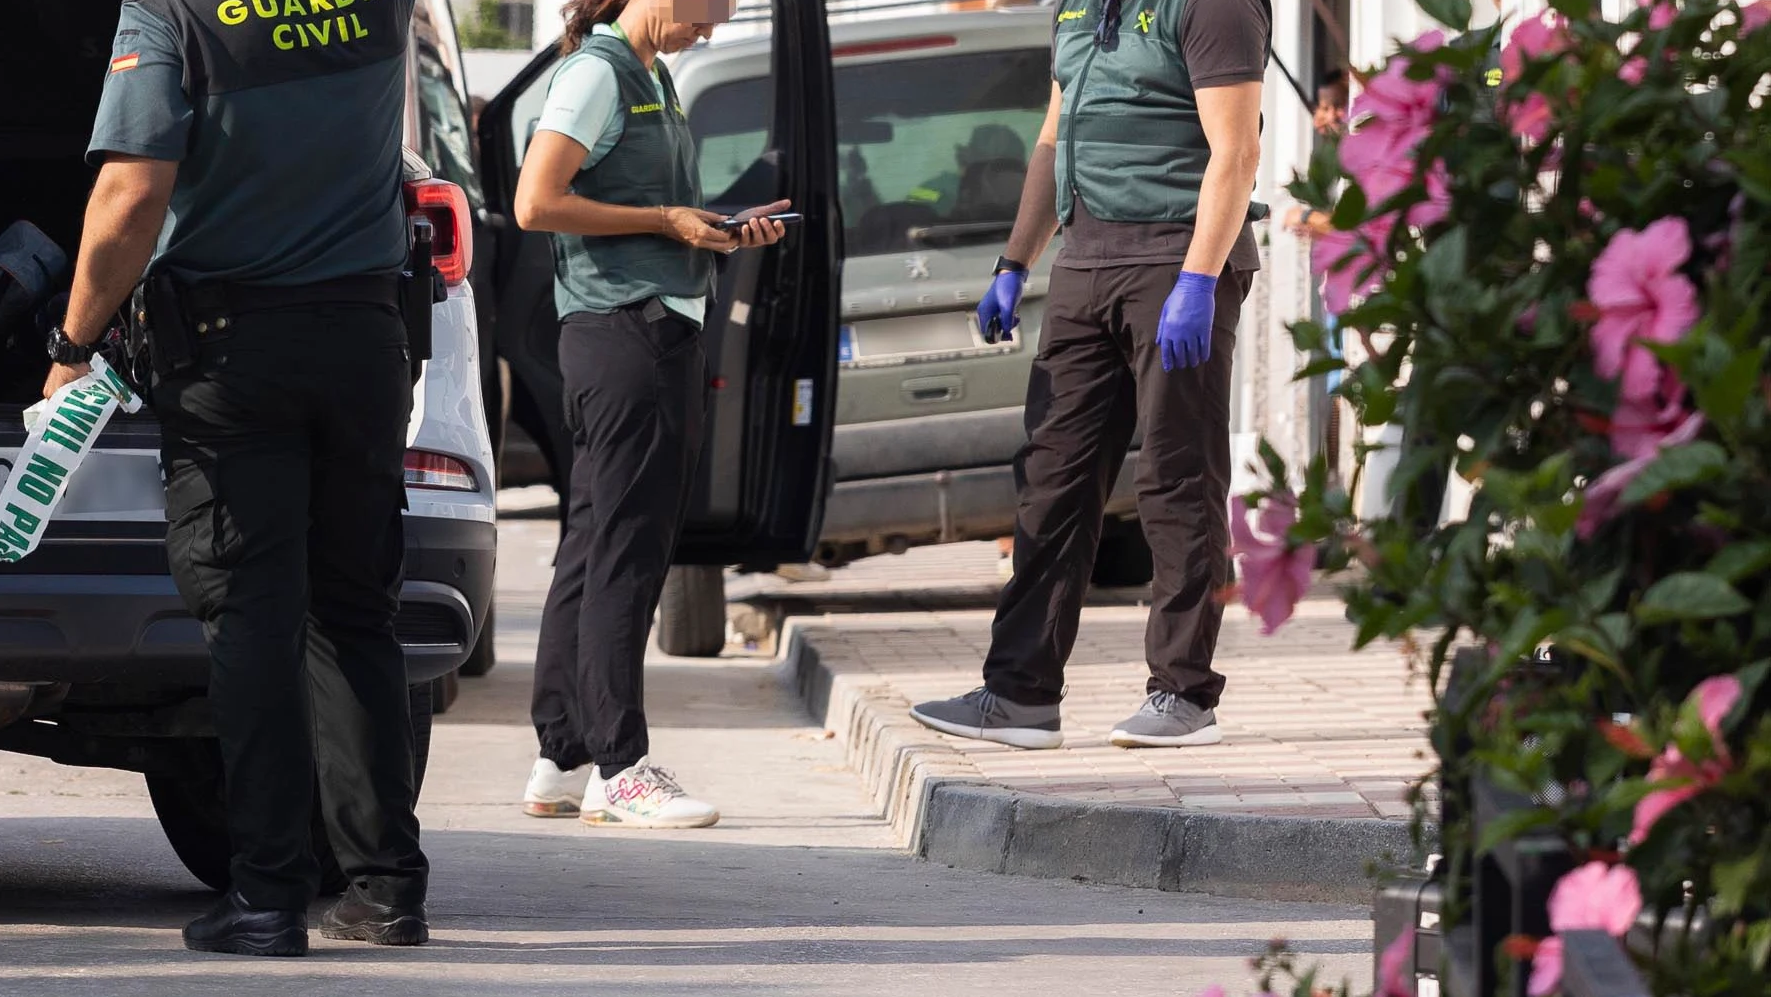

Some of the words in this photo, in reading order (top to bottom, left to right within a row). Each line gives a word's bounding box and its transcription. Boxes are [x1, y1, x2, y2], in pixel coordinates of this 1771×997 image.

[272, 13, 369, 50] CIVIL
[41, 388, 111, 454] CIVIL
[16, 452, 69, 506] NO
